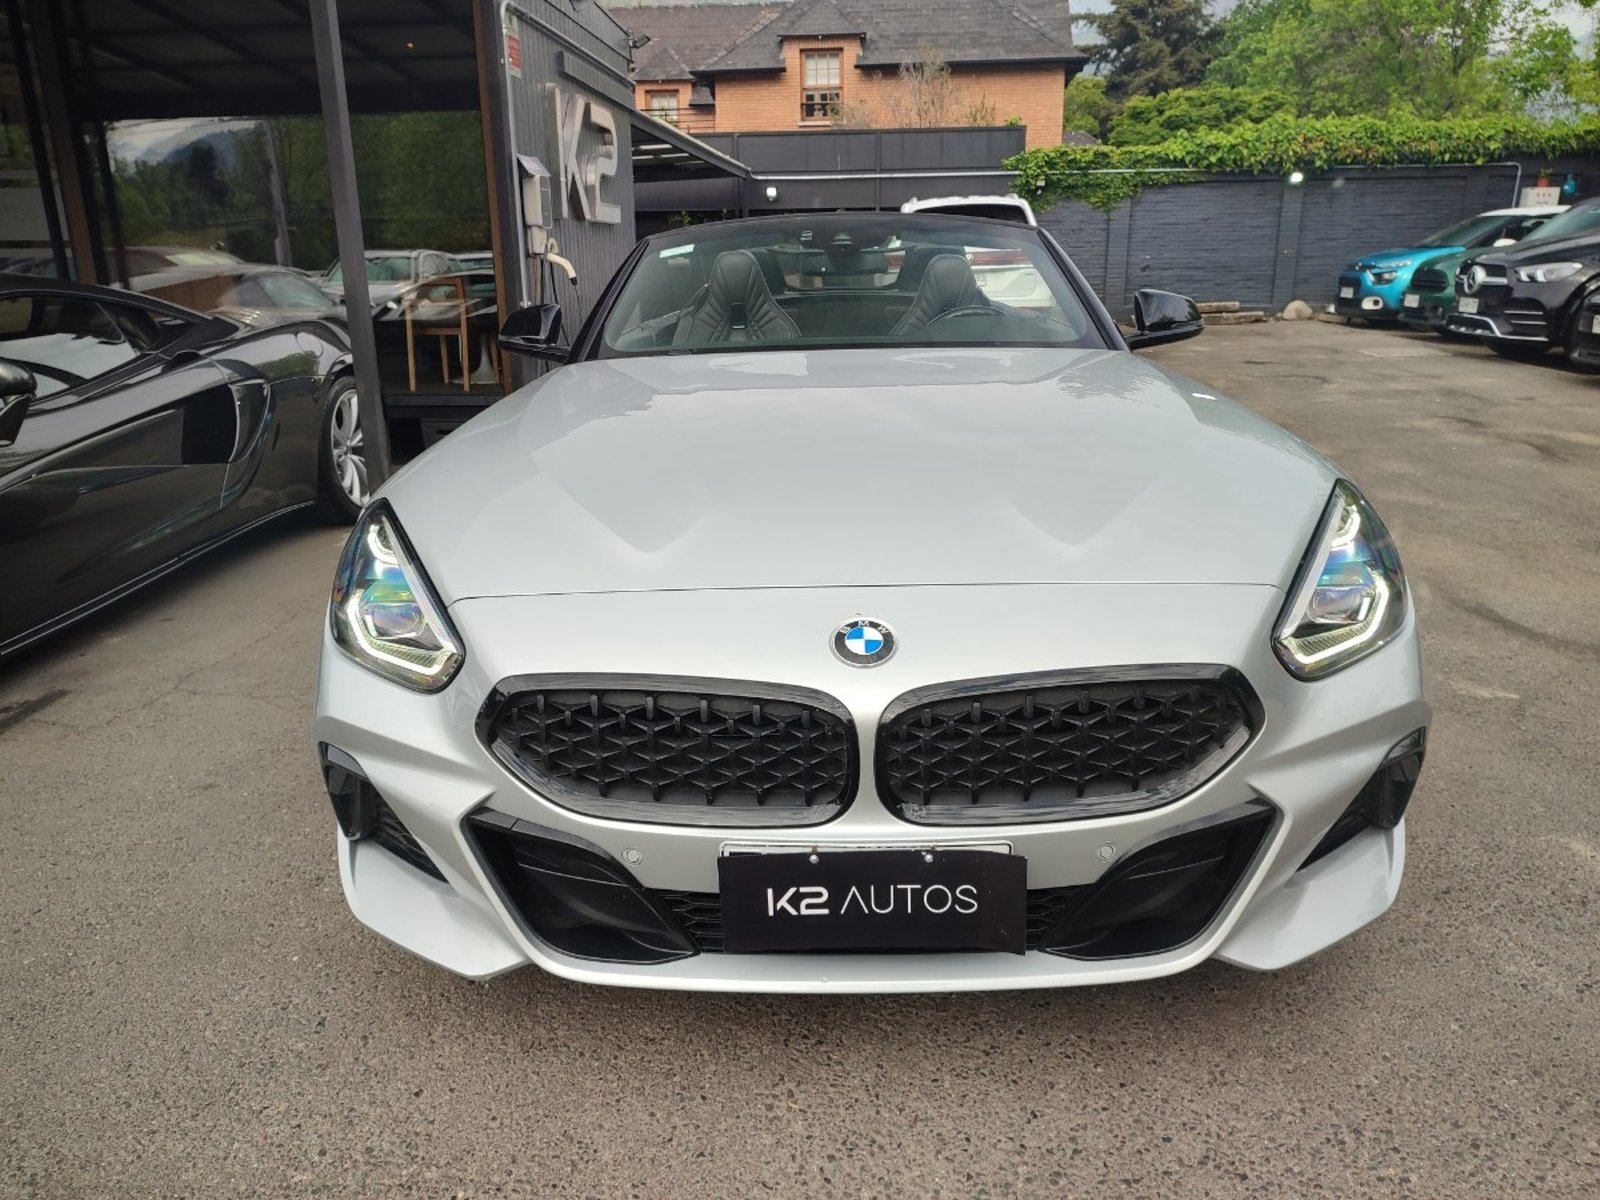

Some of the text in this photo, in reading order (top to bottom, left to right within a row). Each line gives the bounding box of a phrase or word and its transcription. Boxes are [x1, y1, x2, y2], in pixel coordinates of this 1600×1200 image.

[548, 83, 621, 223] K2
[767, 884, 978, 916] K2 AUTOS
